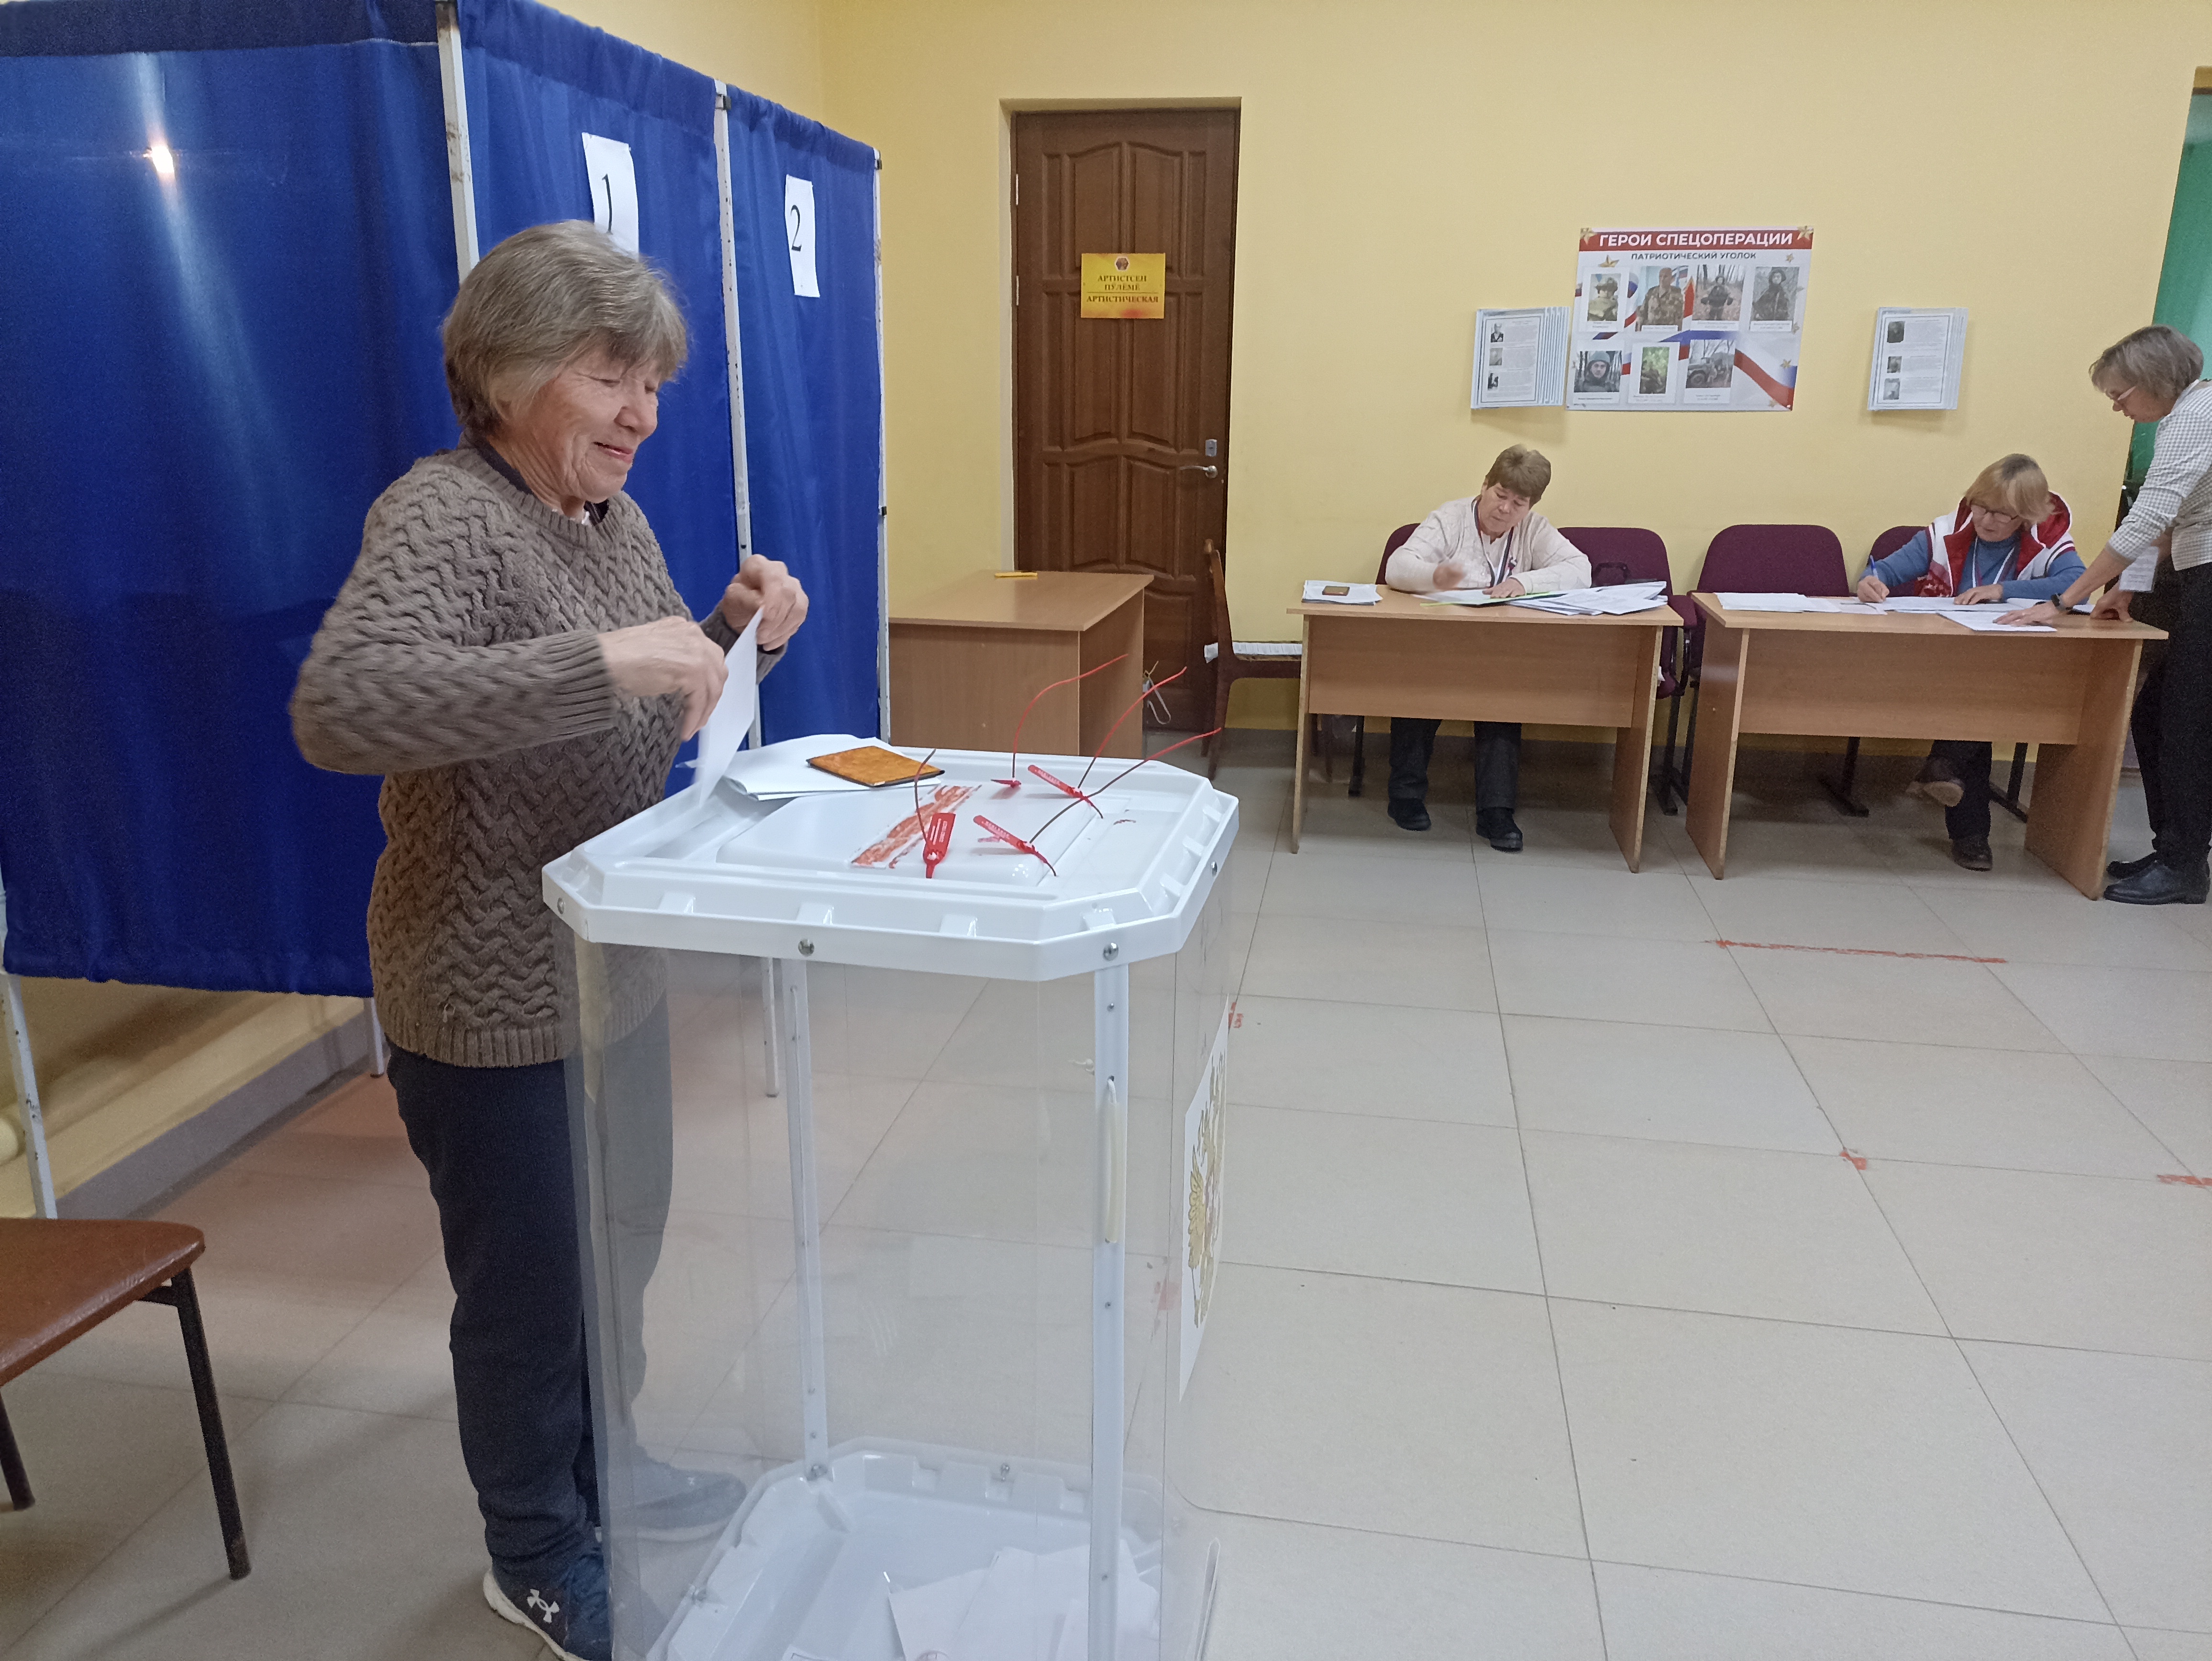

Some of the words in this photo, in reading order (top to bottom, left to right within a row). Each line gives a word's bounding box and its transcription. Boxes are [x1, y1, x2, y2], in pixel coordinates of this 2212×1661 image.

[601, 173, 613, 235] 1
[790, 204, 802, 252] 2
[1600, 233, 1652, 247] ГЕРОИ
[1656, 233, 1793, 248] СПЕЦОПЕРАЦИИ
[1631, 252, 1717, 260] ПАТРИОТИЧЕСКИЙ
